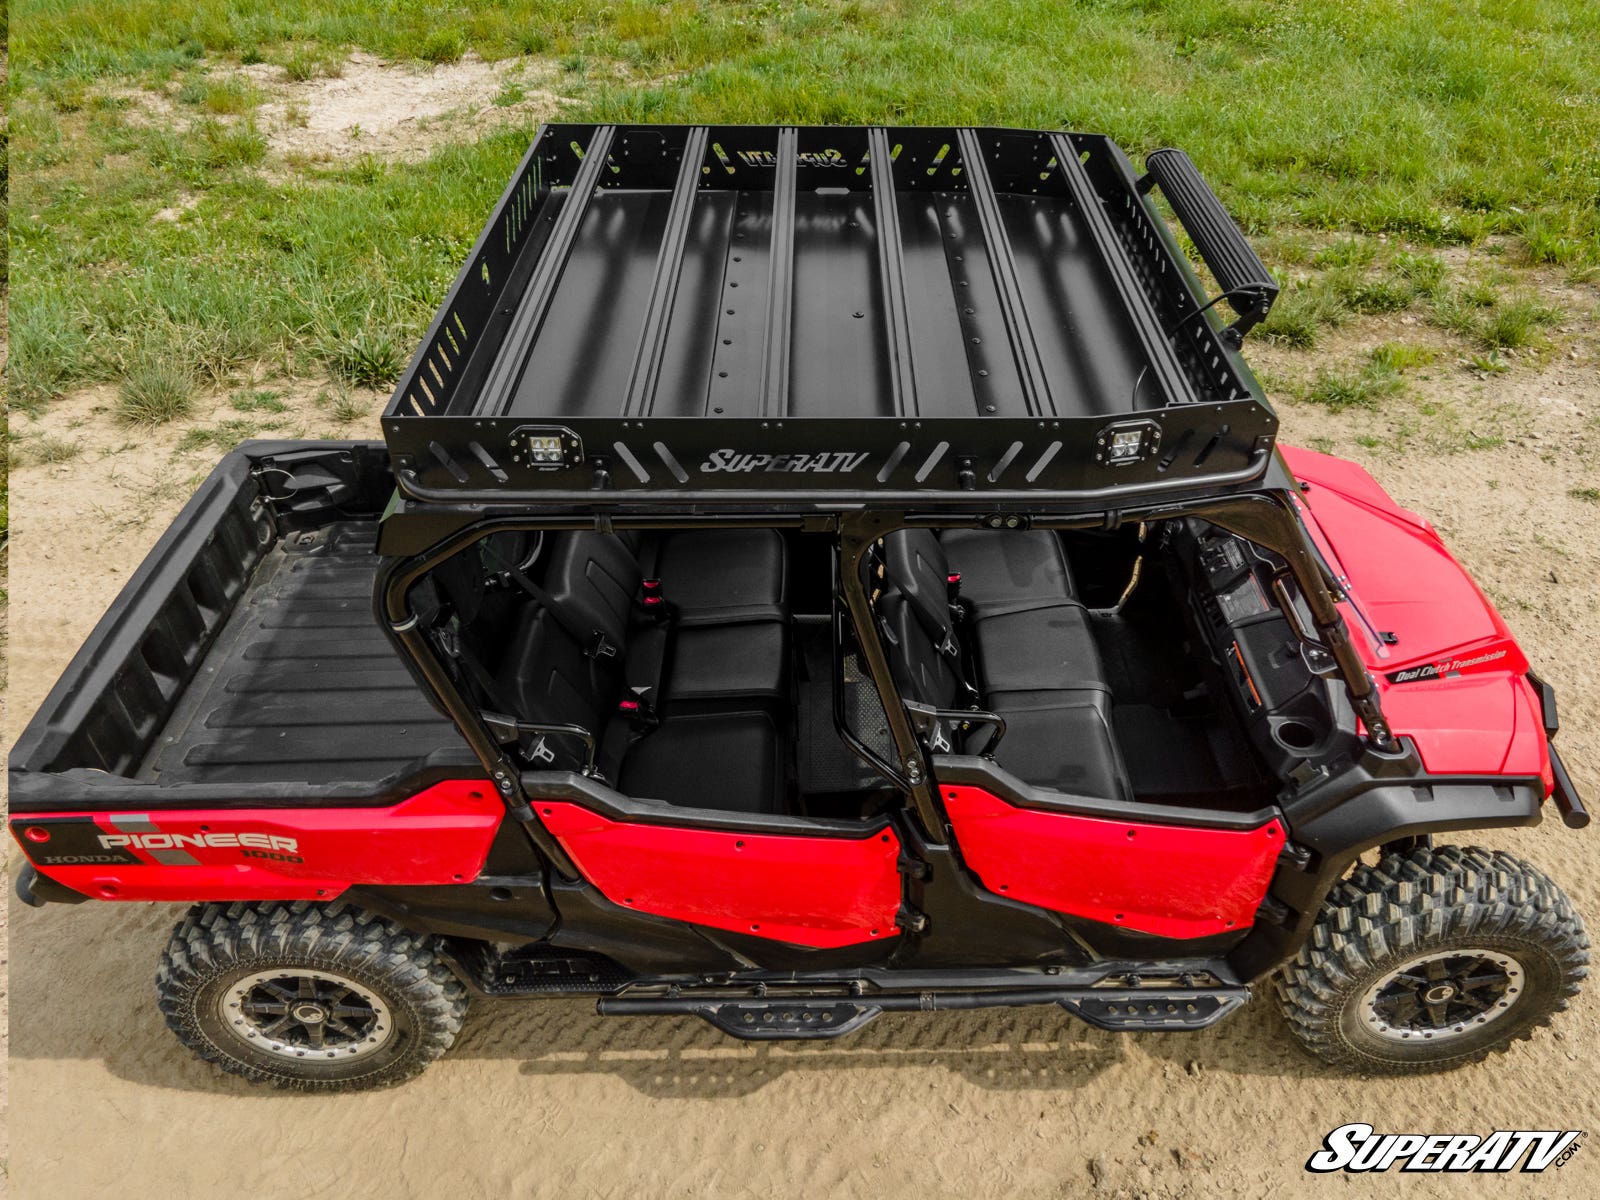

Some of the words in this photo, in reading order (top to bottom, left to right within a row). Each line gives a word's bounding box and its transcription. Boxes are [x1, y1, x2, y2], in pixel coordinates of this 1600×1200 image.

[700, 448, 870, 473] SUPERATV
[1395, 668, 1422, 682] Dual
[1420, 662, 1450, 677] Clutch
[1451, 650, 1507, 670] Transmission
[97, 832, 298, 854] PIONEER
[45, 853, 128, 865] HONDA
[240, 849, 304, 865] 1000
